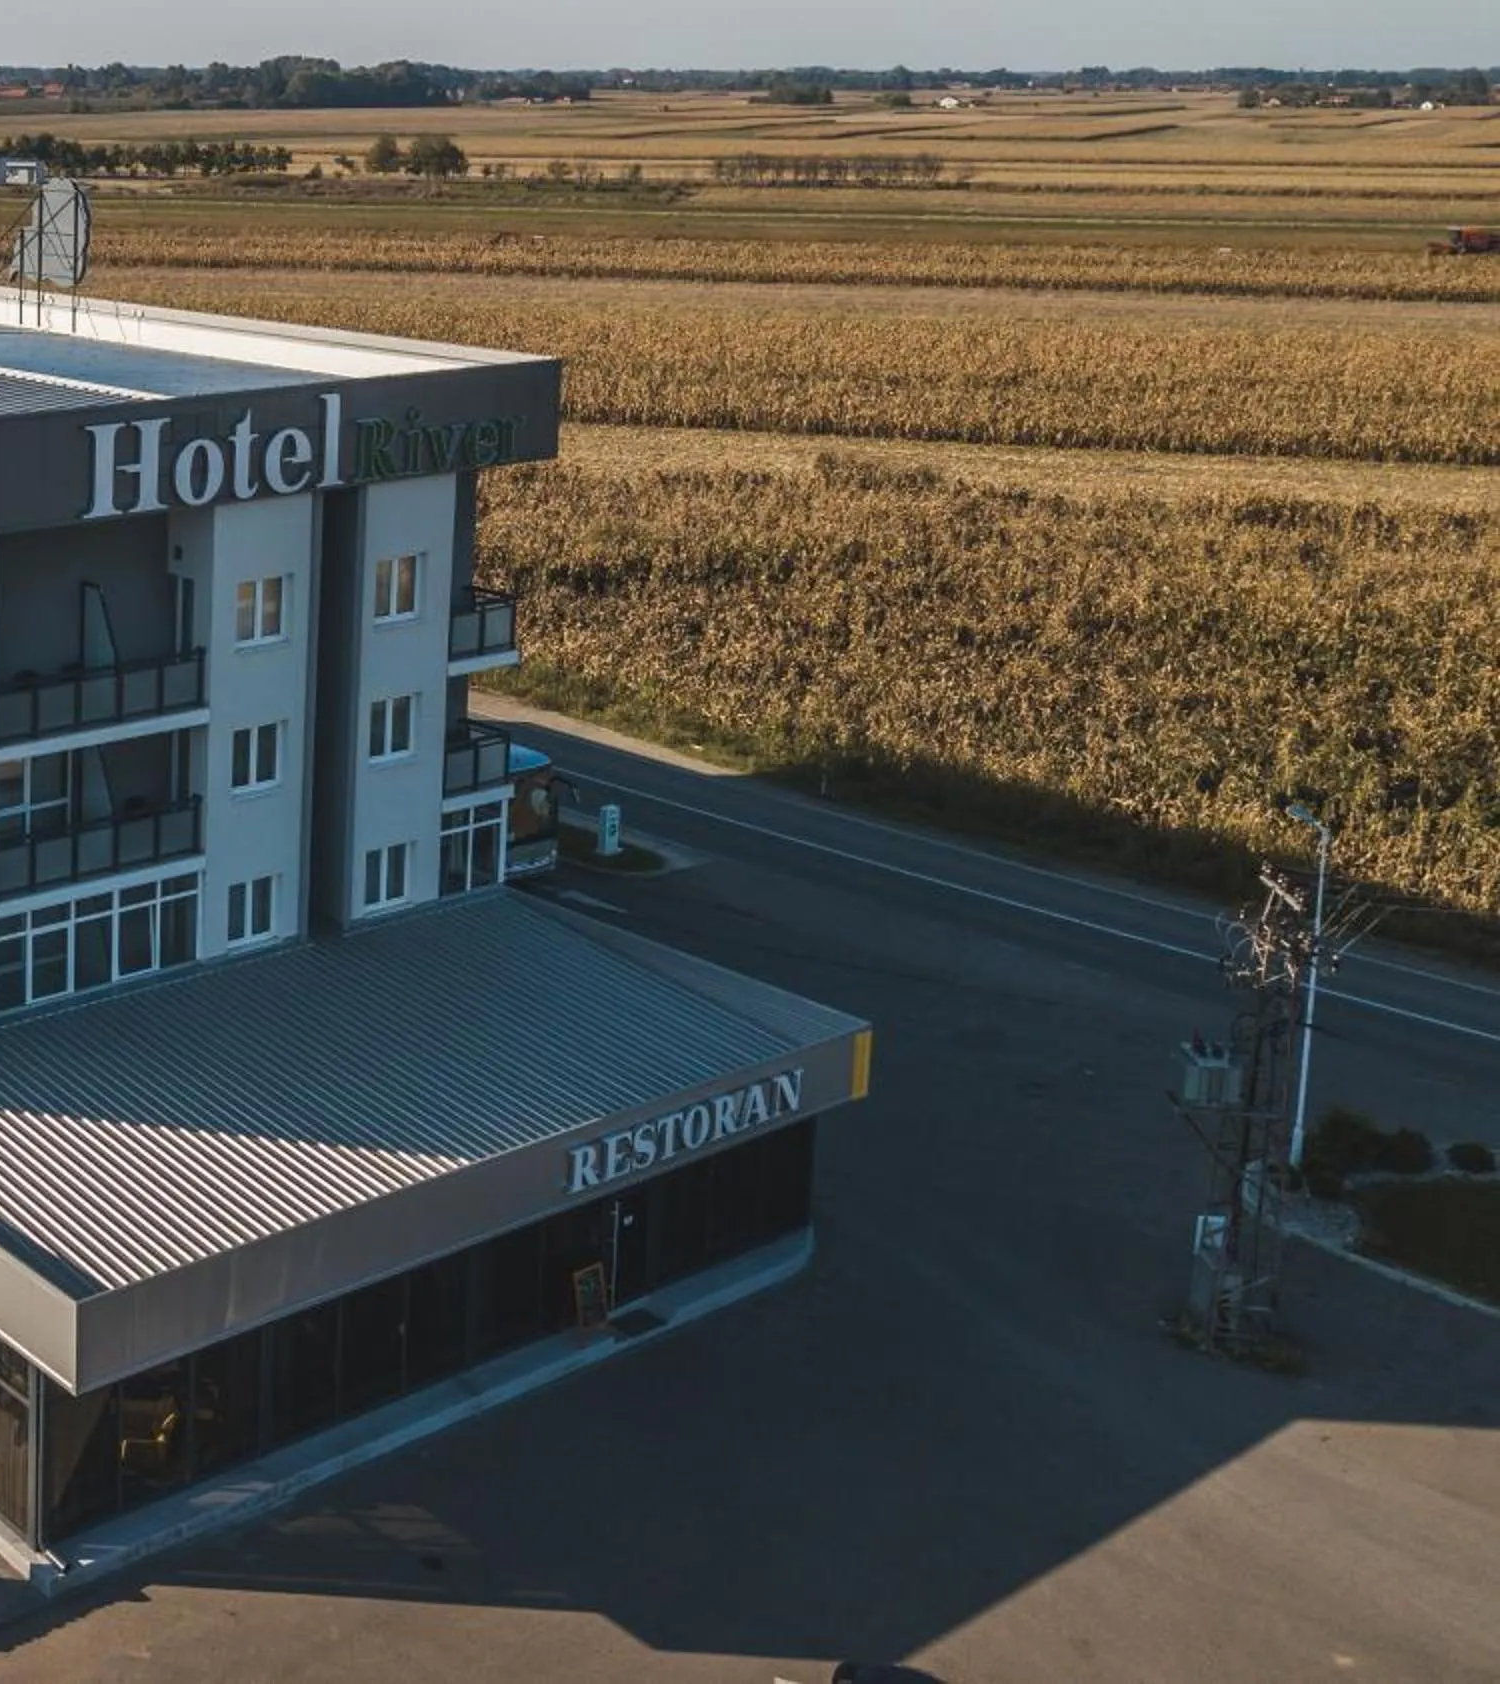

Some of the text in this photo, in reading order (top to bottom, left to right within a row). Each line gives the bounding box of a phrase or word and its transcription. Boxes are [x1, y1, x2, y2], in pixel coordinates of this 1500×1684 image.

[83, 393, 528, 519] Hotel River
[565, 1068, 804, 1194] RESTORAN
